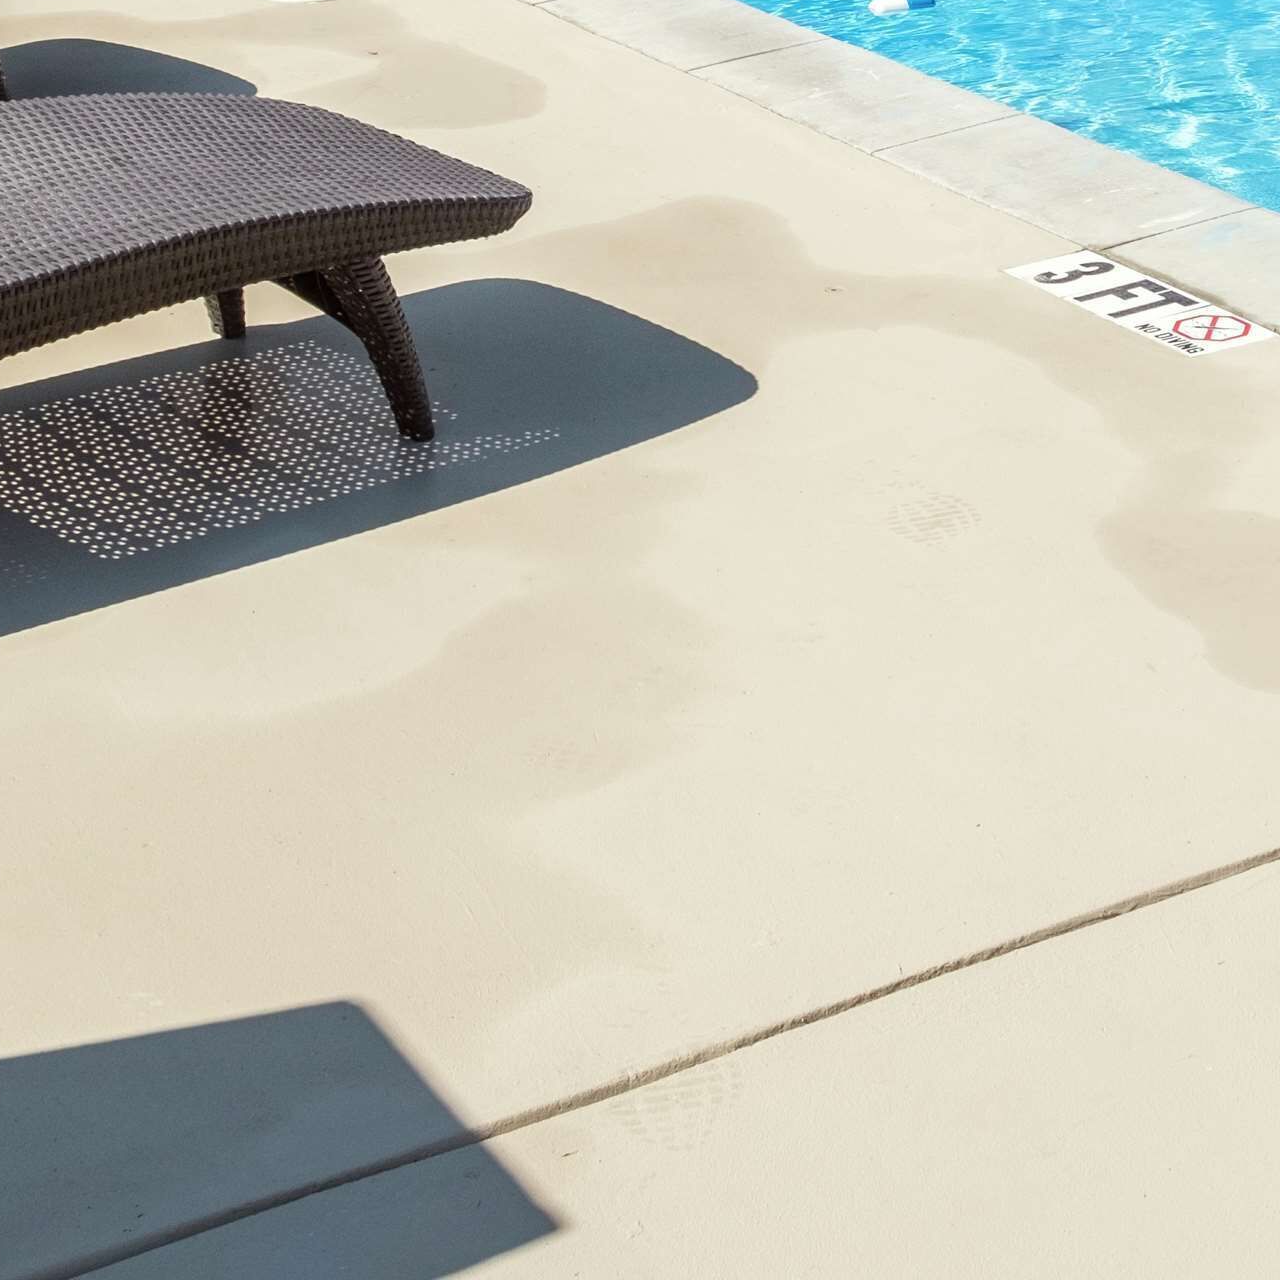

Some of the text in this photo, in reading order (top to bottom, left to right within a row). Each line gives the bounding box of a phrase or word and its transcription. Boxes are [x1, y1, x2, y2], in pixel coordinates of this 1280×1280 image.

[1033, 261, 1200, 319] 3 FT
[1134, 323, 1205, 354] NO DIVING
